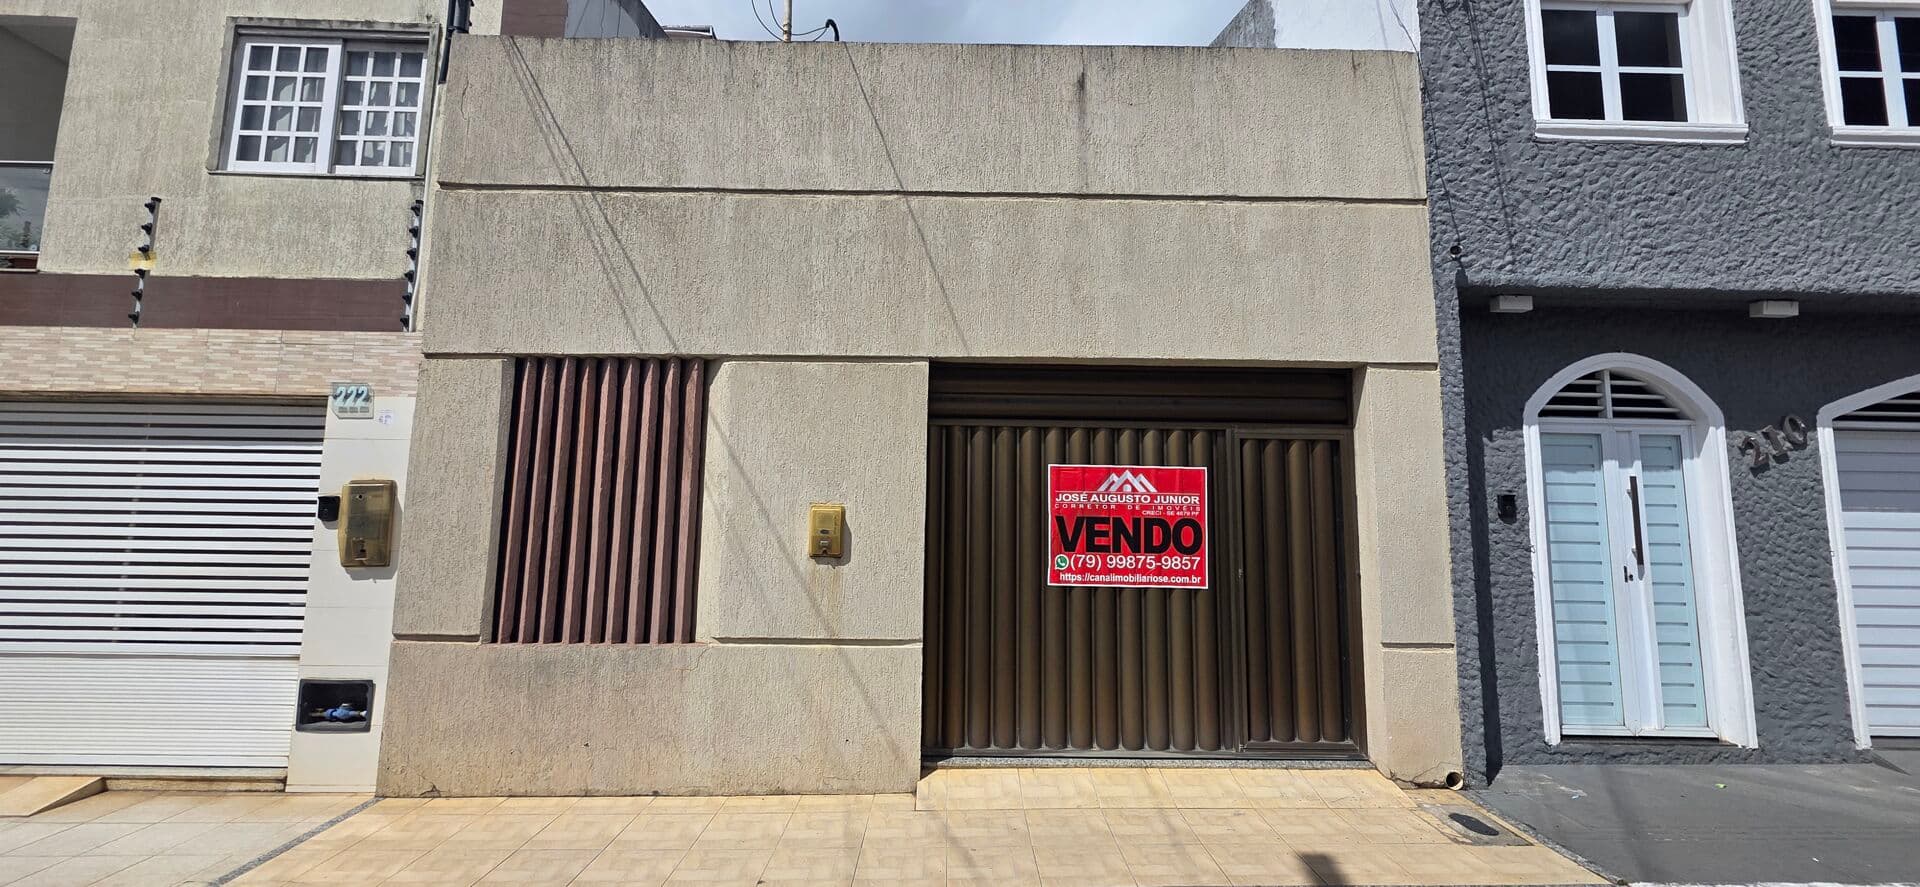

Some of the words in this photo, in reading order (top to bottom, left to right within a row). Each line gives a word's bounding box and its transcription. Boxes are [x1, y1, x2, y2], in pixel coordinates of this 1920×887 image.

[334, 386, 369, 407] 222
[1737, 415, 1807, 468] 210
[1055, 492, 1088, 502] JOSÉ
[1090, 494, 1151, 503] AUGUSTO
[1154, 495, 1200, 504] JUNIOR
[1055, 516, 1203, 555] VENDO
[1070, 554, 1102, 571] (79)
[1106, 555, 1201, 570] 99875-9857
[1059, 572, 1201, 584] https://canalimobiliariose.com.br
